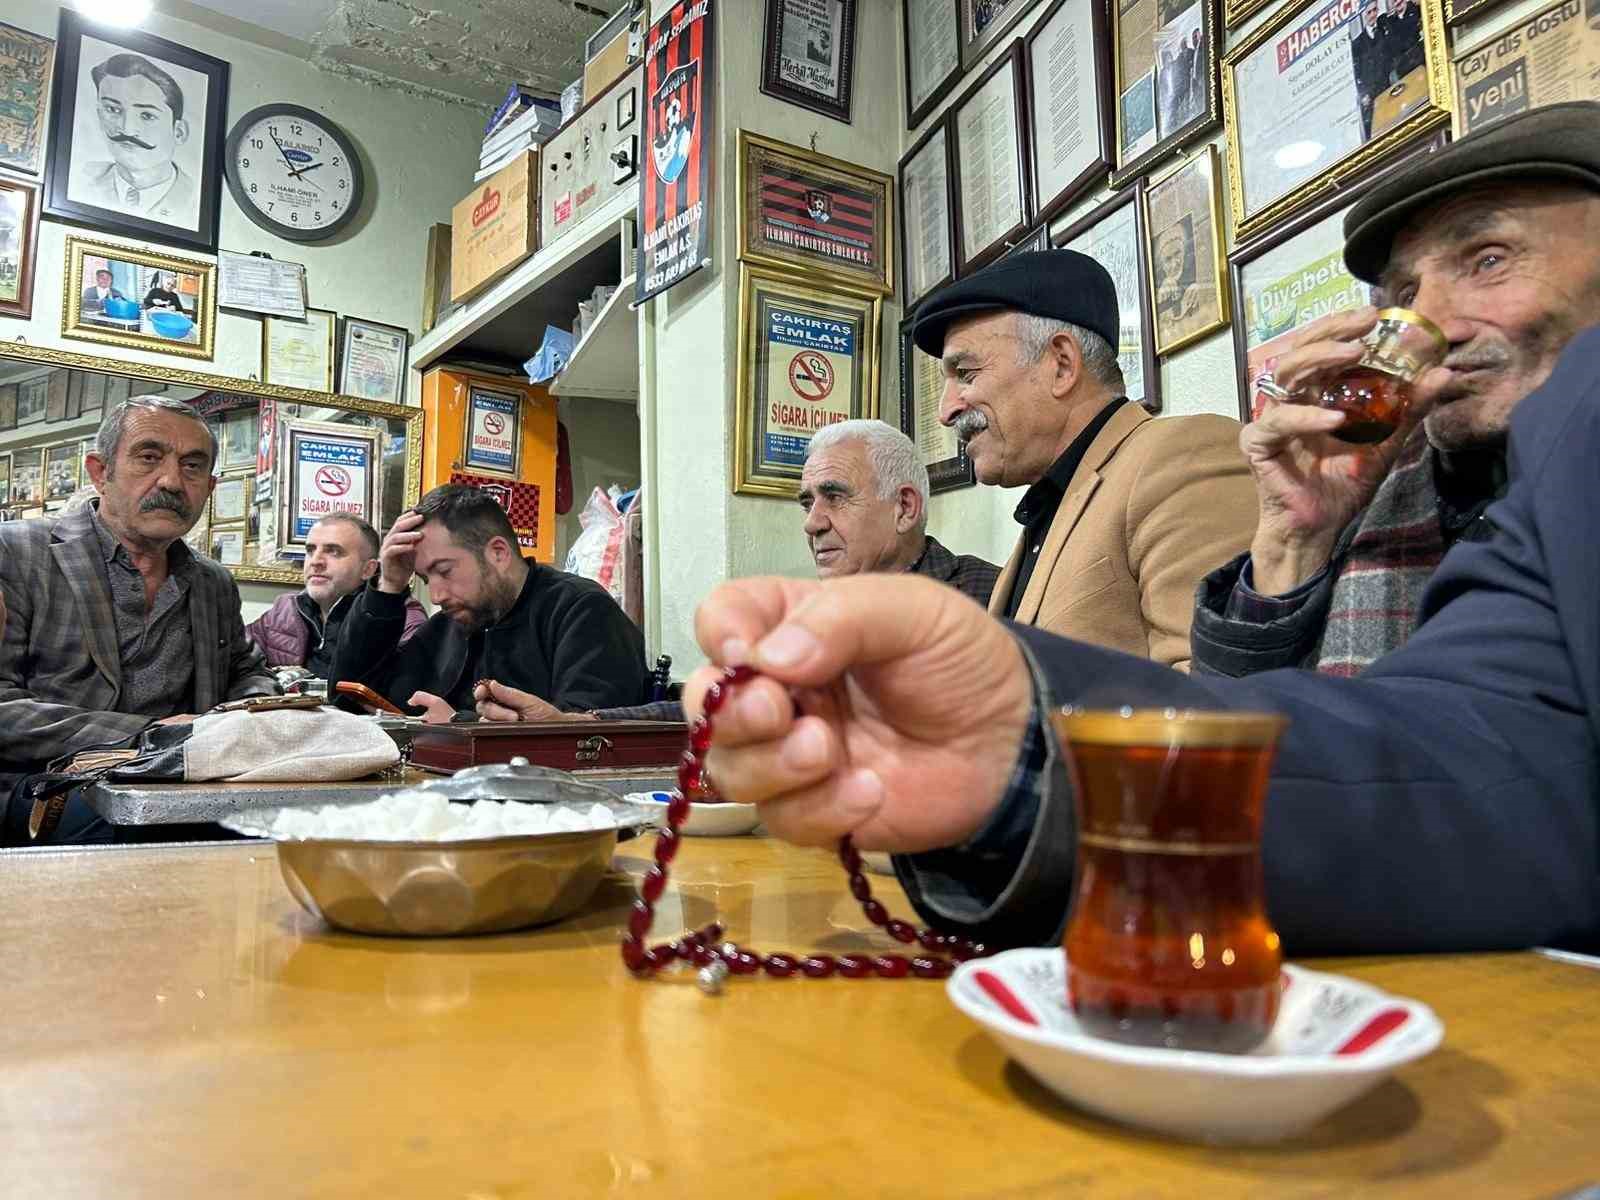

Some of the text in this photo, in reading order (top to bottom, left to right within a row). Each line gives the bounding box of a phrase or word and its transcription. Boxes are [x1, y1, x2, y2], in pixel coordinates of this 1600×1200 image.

[1469, 65, 1523, 120] yeni
[268, 126, 278, 136] 11
[290, 125, 302, 136] 12
[250, 139, 263, 150] 10
[317, 137, 323, 146] 1
[242, 159, 250, 168] 9
[332, 157, 340, 167] 2
[250, 183, 257, 193] 8
[338, 179, 345, 189] 3
[268, 202, 275, 211] 7
[331, 200, 338, 209] 4
[291, 212, 298, 222] 6
[314, 211, 321, 221] 5
[772, 324, 849, 347] EMLAK
[771, 401, 808, 428] SİGARA
[301, 450, 362, 463] EMLAK
[302, 497, 330, 513] SİGARA
